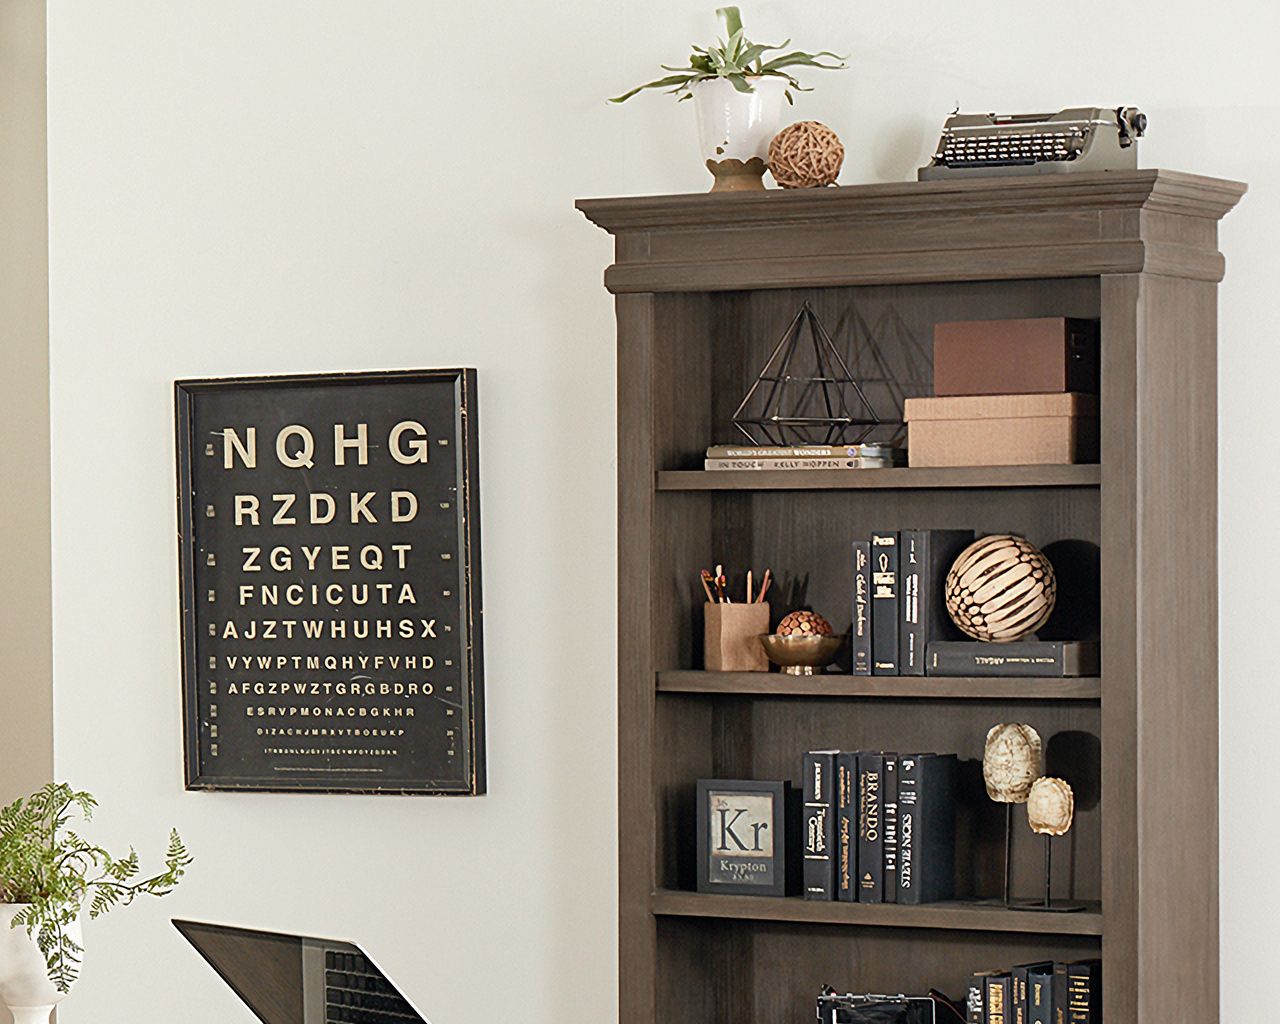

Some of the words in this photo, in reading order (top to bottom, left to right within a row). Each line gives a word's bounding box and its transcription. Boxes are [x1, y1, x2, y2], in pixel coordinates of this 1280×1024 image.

[867, 772, 878, 841] BRANDO
[716, 808, 768, 851] Kr
[720, 860, 767, 874] Krypton
